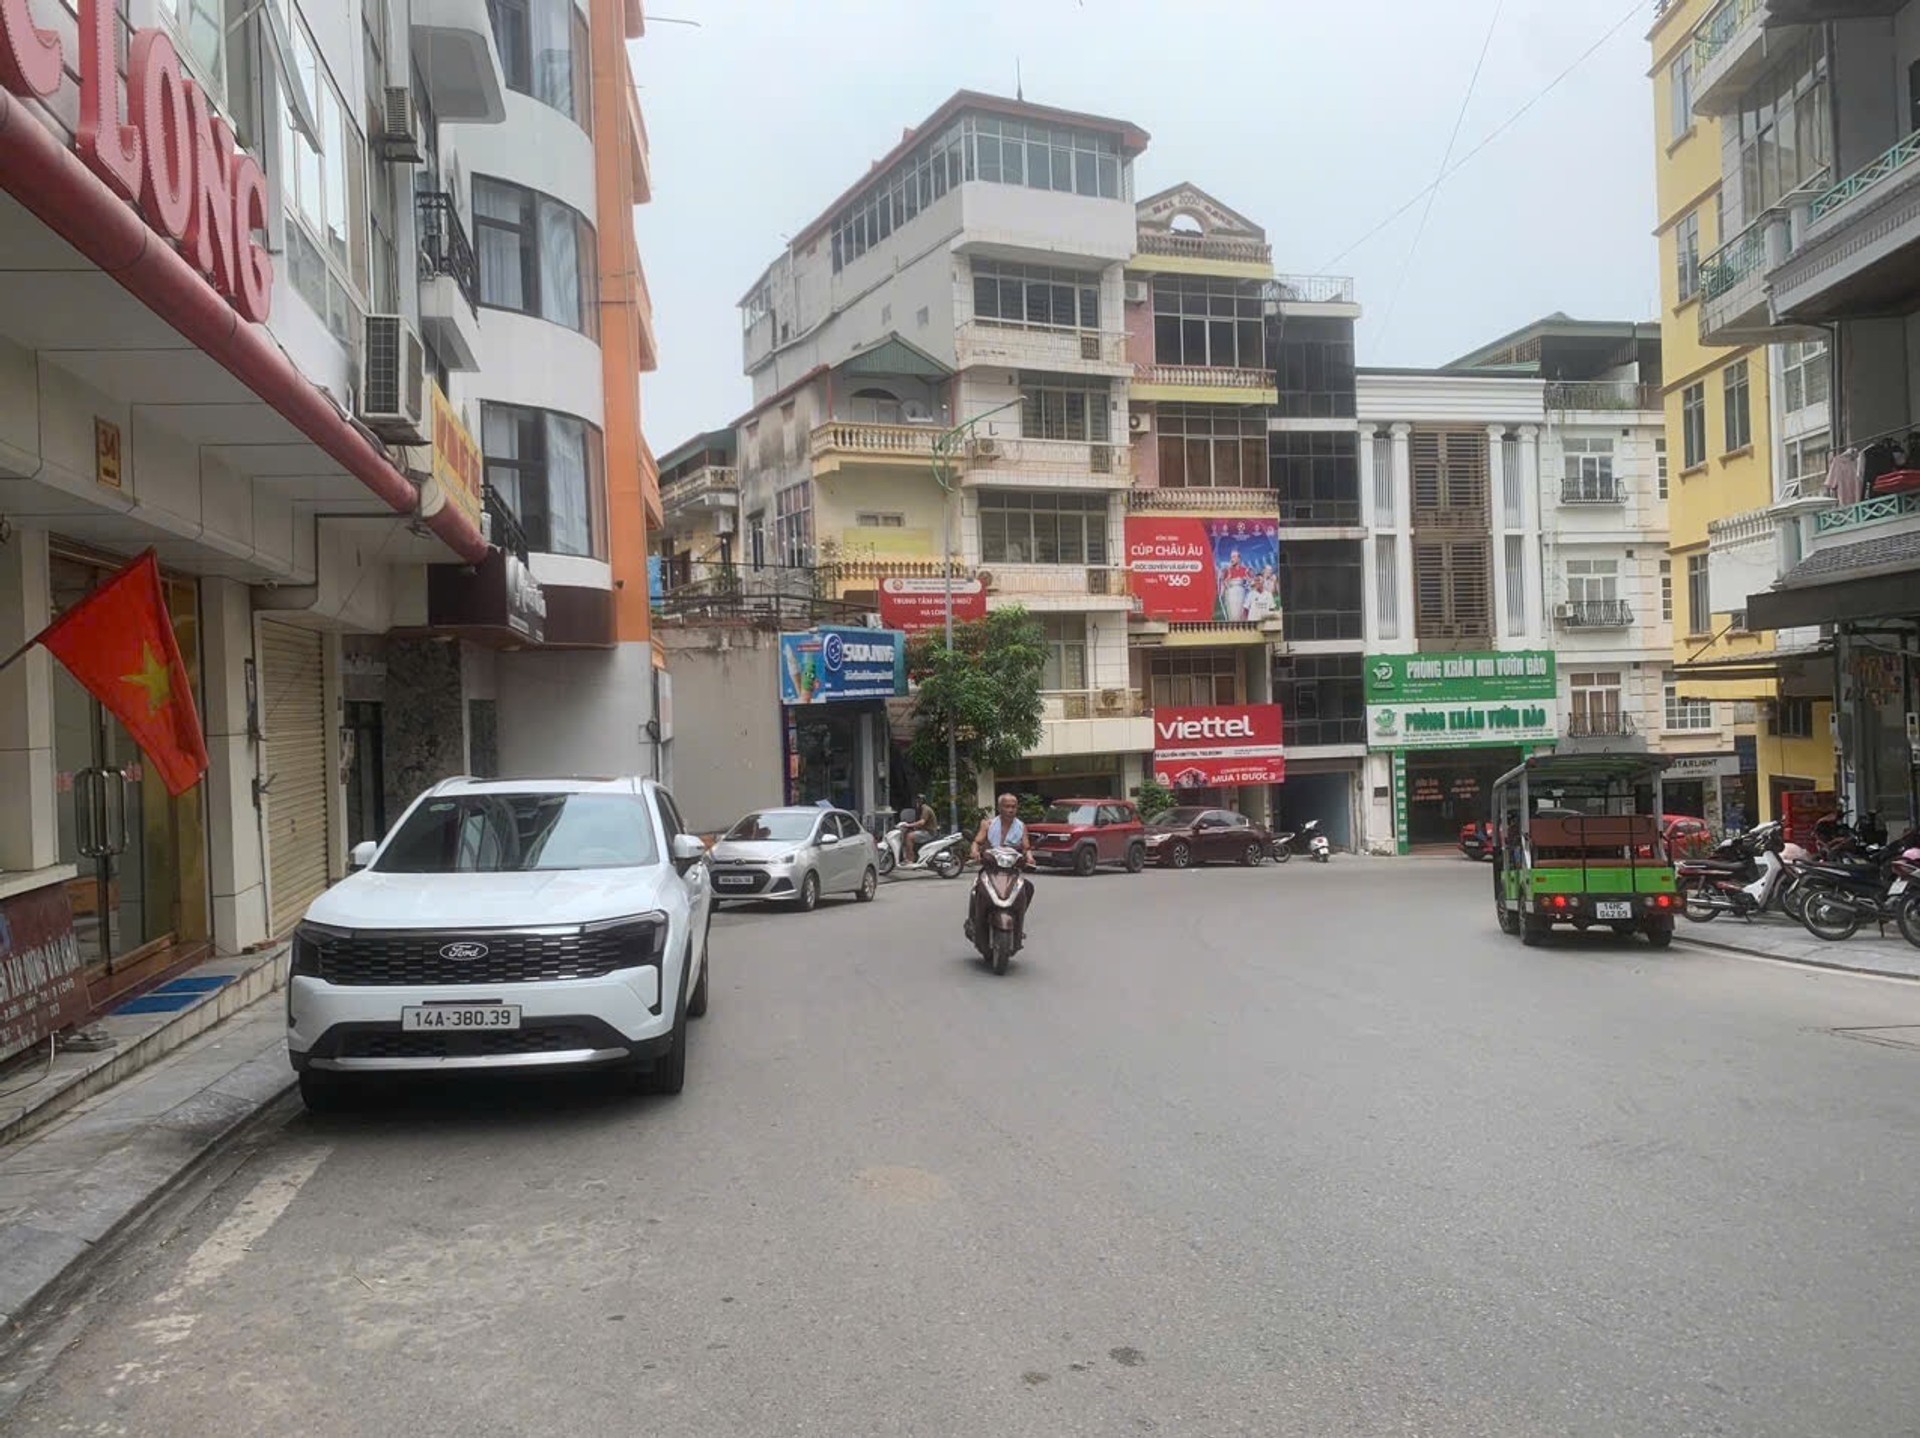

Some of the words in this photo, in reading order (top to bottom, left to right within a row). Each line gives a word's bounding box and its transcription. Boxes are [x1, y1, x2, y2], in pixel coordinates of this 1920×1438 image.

[1131, 542, 1154, 556] CÚP
[1155, 543, 1186, 556] CHÂU
[1187, 543, 1203, 556] ÂU
[1406, 657, 1442, 679] PHÒNG
[1443, 655, 1474, 678] KHÁM
[1156, 715, 1255, 740] viettel
[1405, 707, 1446, 732] PHÒNG
[1448, 706, 1485, 730] KHÁM
[448, 944, 480, 957] Ford
[415, 1009, 511, 1027] 14A-380.39
